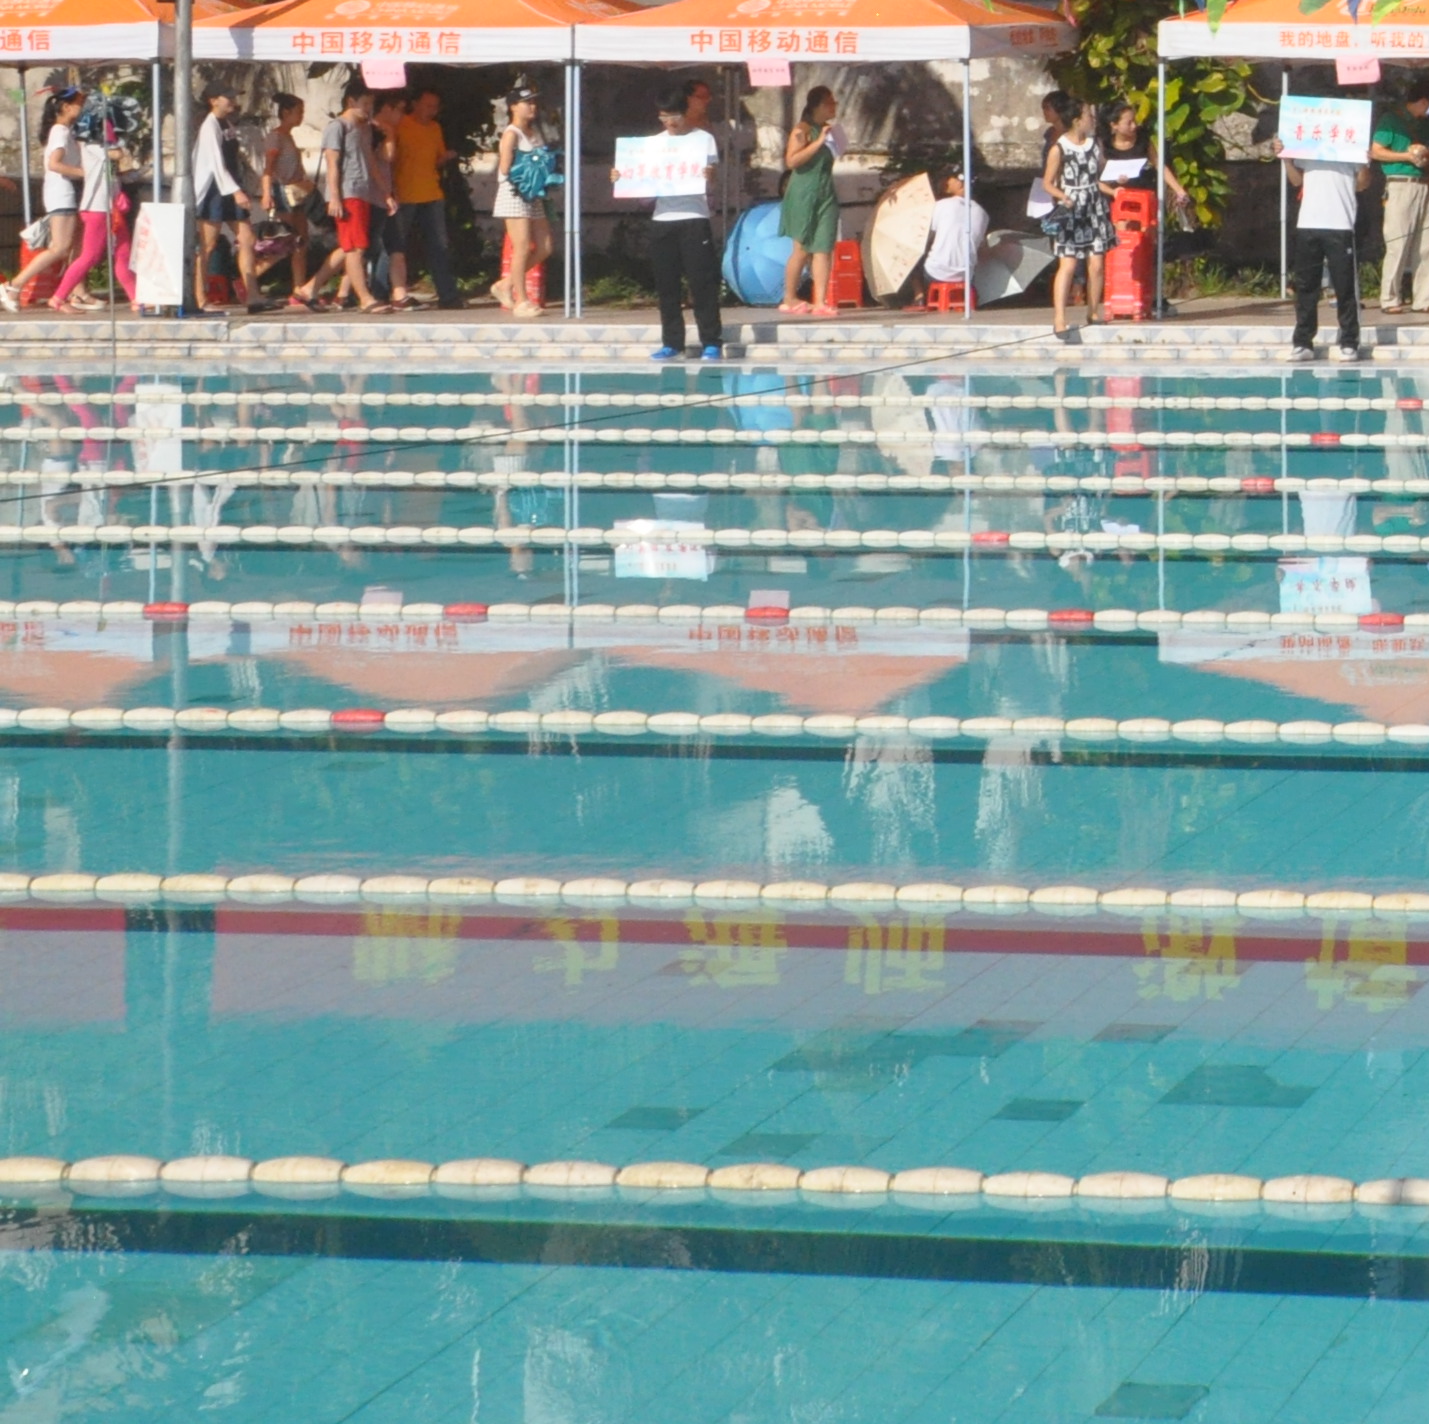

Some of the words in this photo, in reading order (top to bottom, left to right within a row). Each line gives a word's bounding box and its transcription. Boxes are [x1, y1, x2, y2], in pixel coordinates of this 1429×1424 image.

[291, 31, 462, 55] 中国移动通信
[689, 29, 860, 55] 中国移动通信
[1293, 122, 1357, 144] 音乐学院
